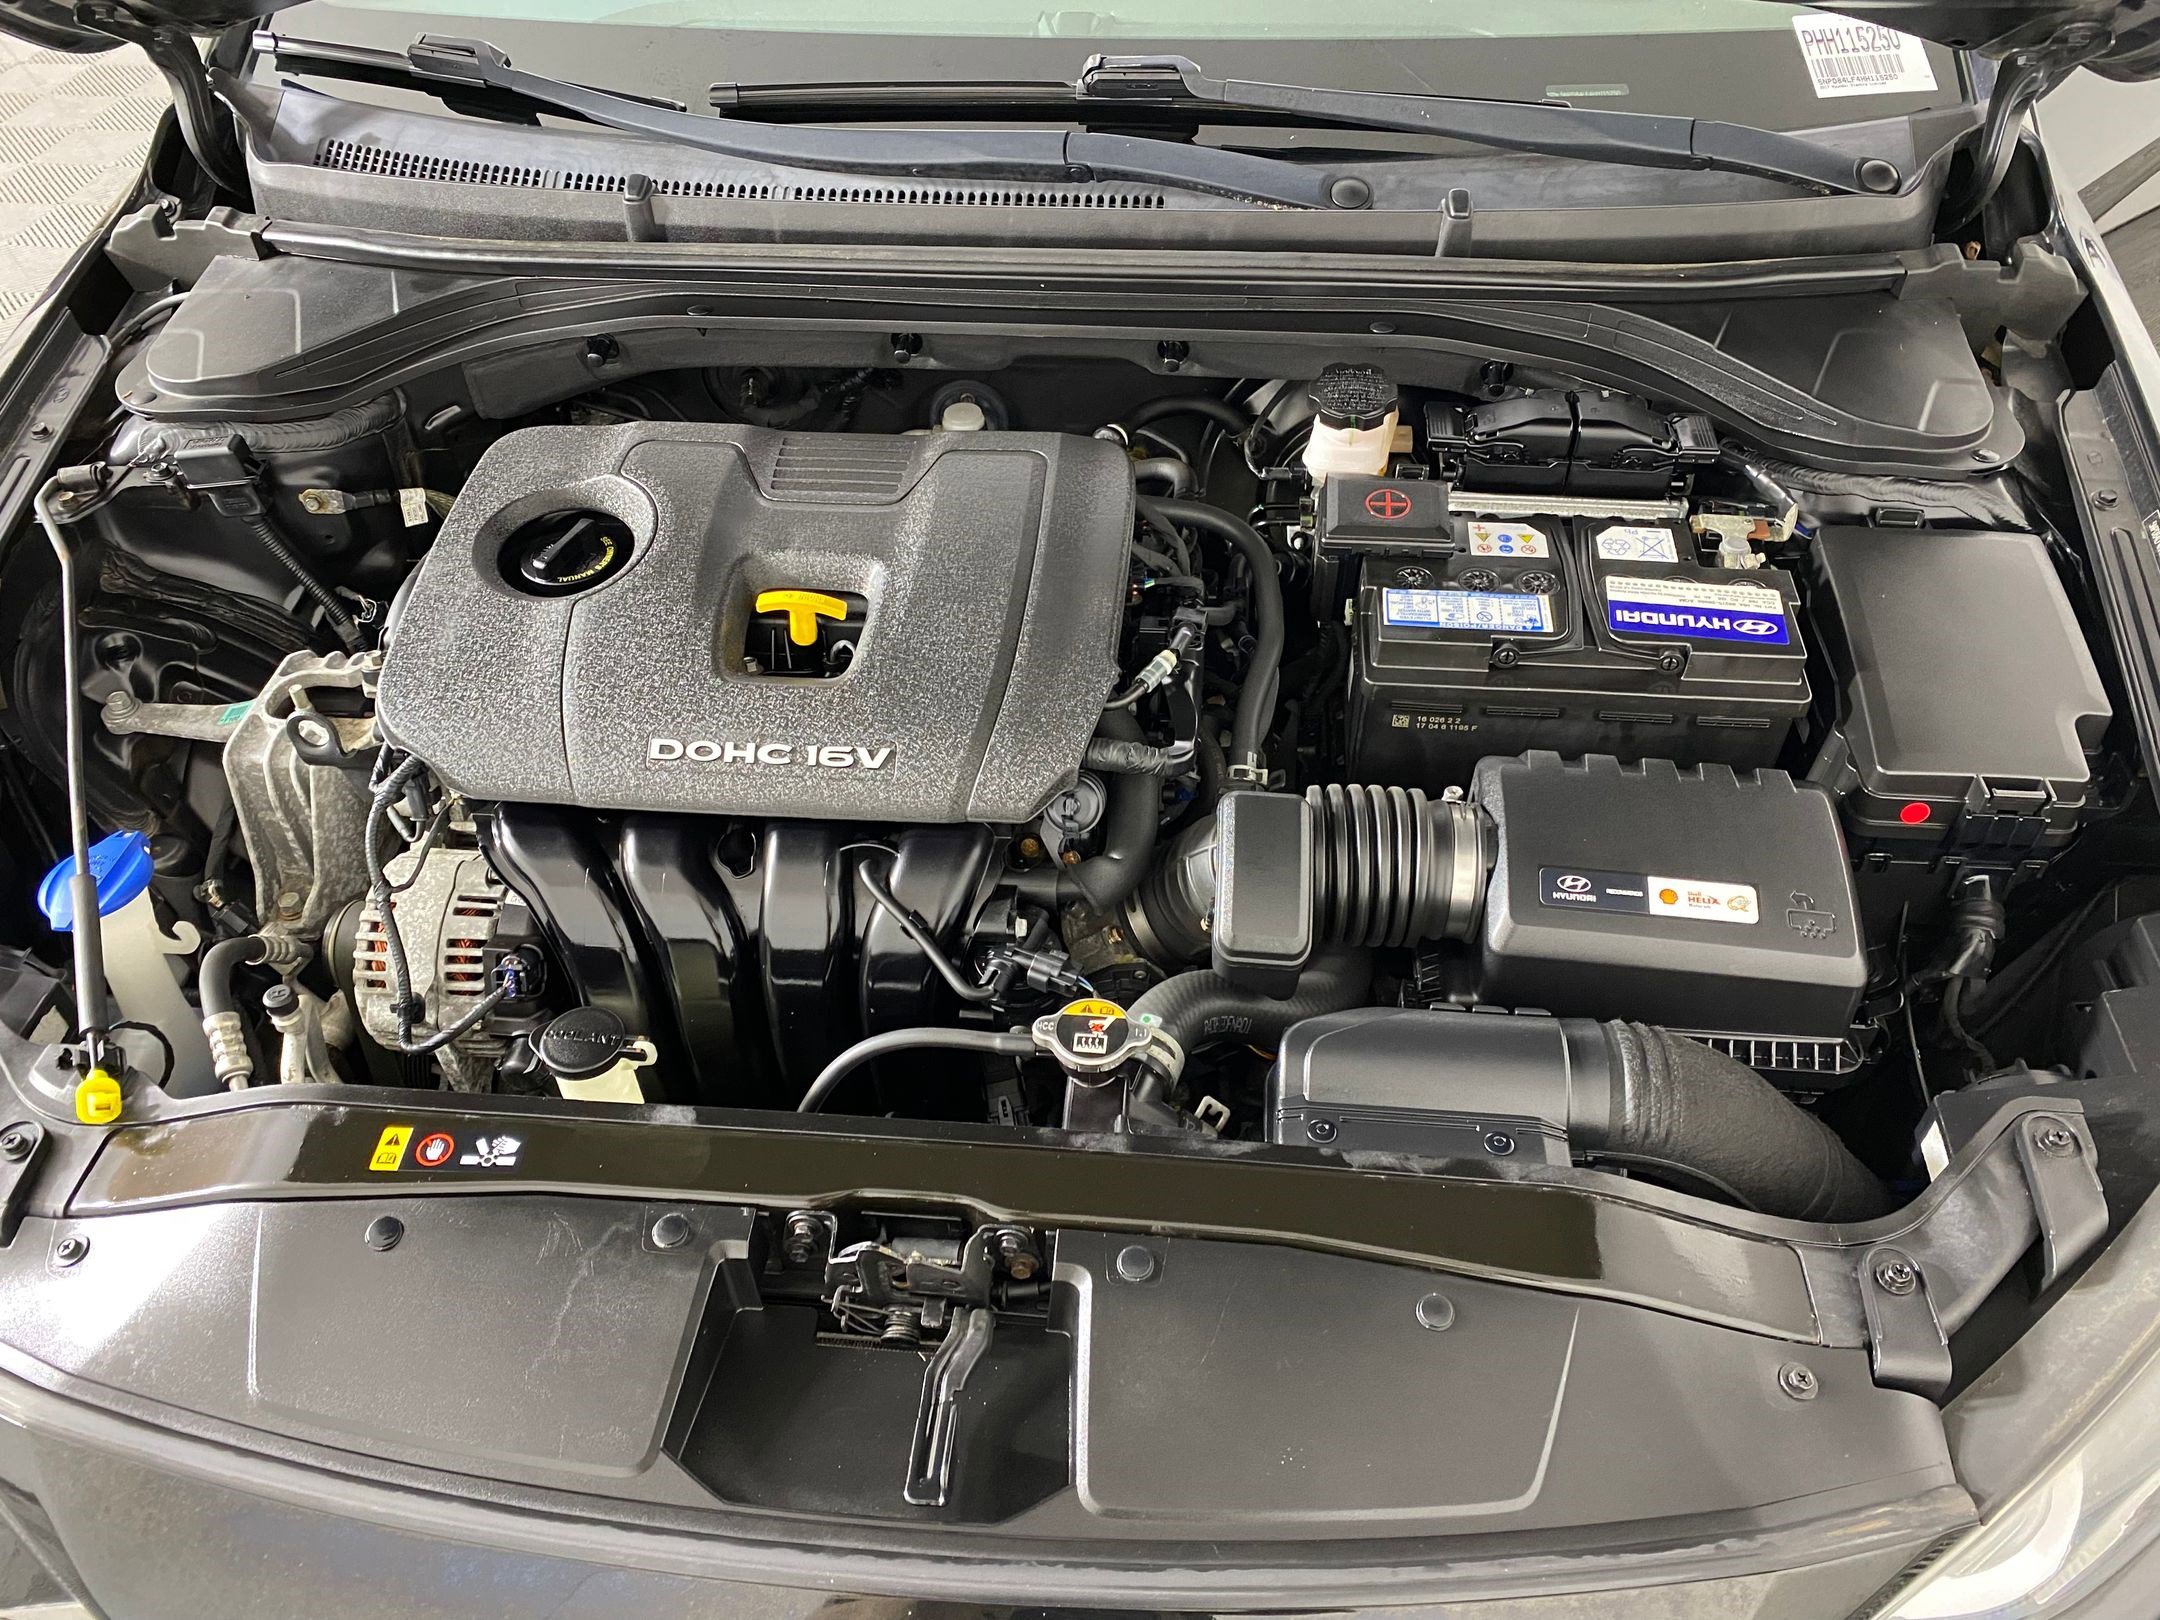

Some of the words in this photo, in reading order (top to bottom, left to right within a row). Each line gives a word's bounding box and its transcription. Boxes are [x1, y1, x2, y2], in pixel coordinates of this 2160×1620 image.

[1802, 26, 1901, 56] PHH115250
[557, 570, 595, 582] MANUAL
[1616, 610, 1731, 630] HYUNDAI
[649, 738, 793, 765] DOHC
[806, 744, 891, 769] 16V
[1552, 892, 1596, 902] HYUNDAI
[1688, 895, 1720, 905] HELIX
[1036, 1021, 1054, 1031] HCC
[544, 1030, 618, 1046] COOLANT
